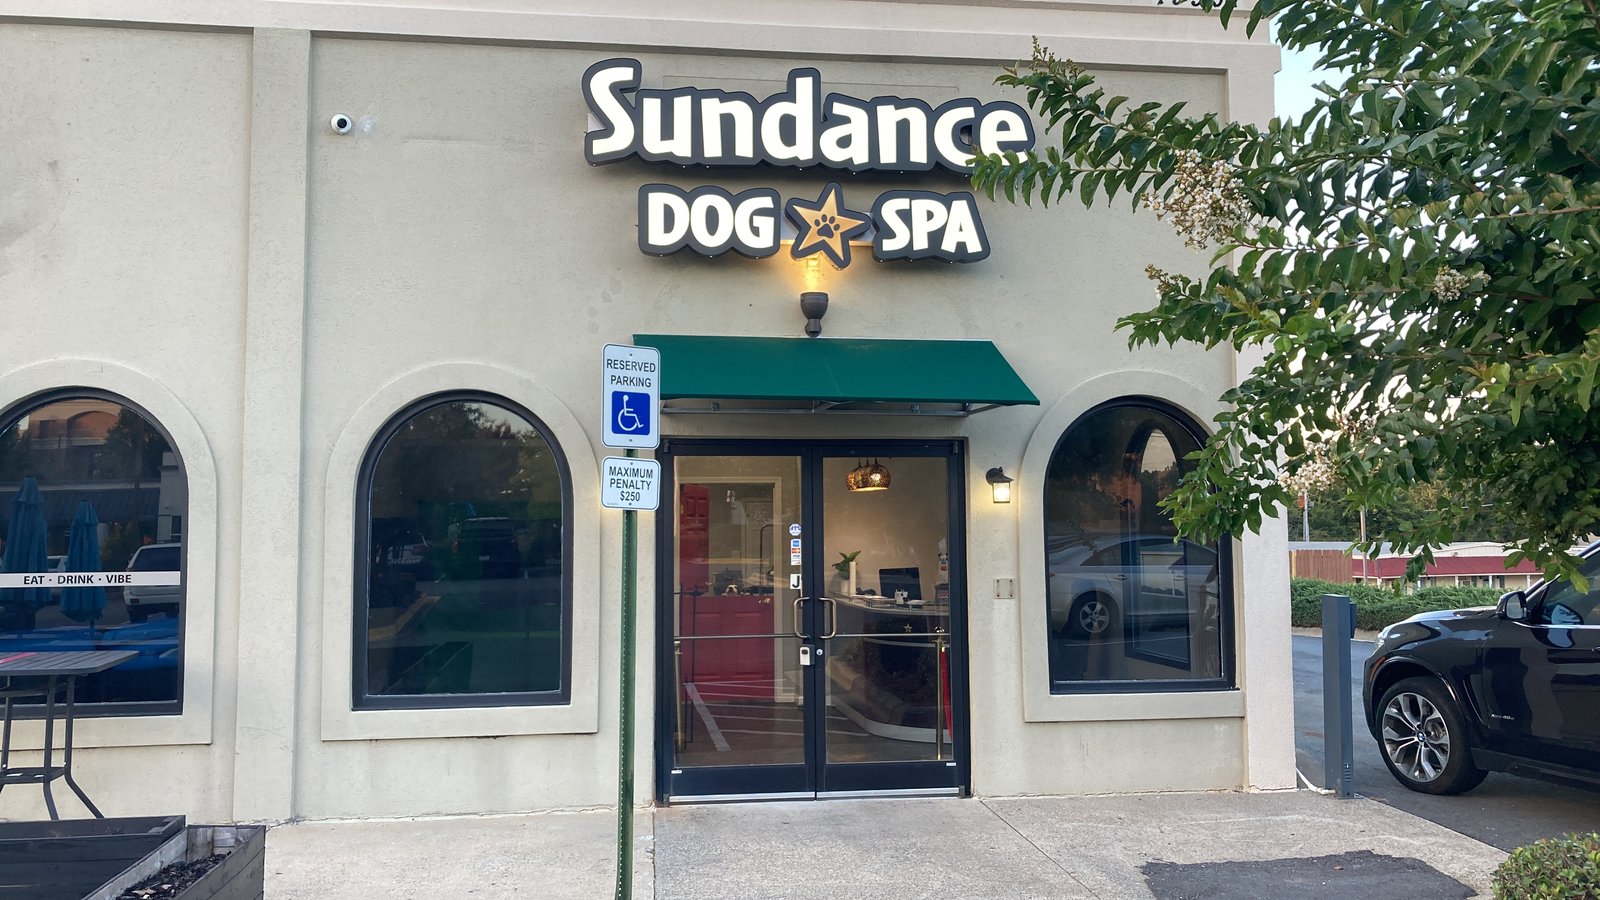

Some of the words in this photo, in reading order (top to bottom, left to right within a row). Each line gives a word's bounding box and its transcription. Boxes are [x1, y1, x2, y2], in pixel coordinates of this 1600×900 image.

[589, 66, 1028, 168] Sundance
[647, 192, 775, 249] DOG
[881, 197, 983, 253] SPA
[607, 359, 656, 372] RESERVED
[610, 375, 652, 388] PARKING
[609, 466, 653, 479] MAXIMUM
[609, 478, 652, 491] PENALTY
[619, 491, 641, 502] $250
[23, 575, 45, 585] EAT
[57, 574, 94, 584] DRINK
[105, 574, 132, 584] VIBE
